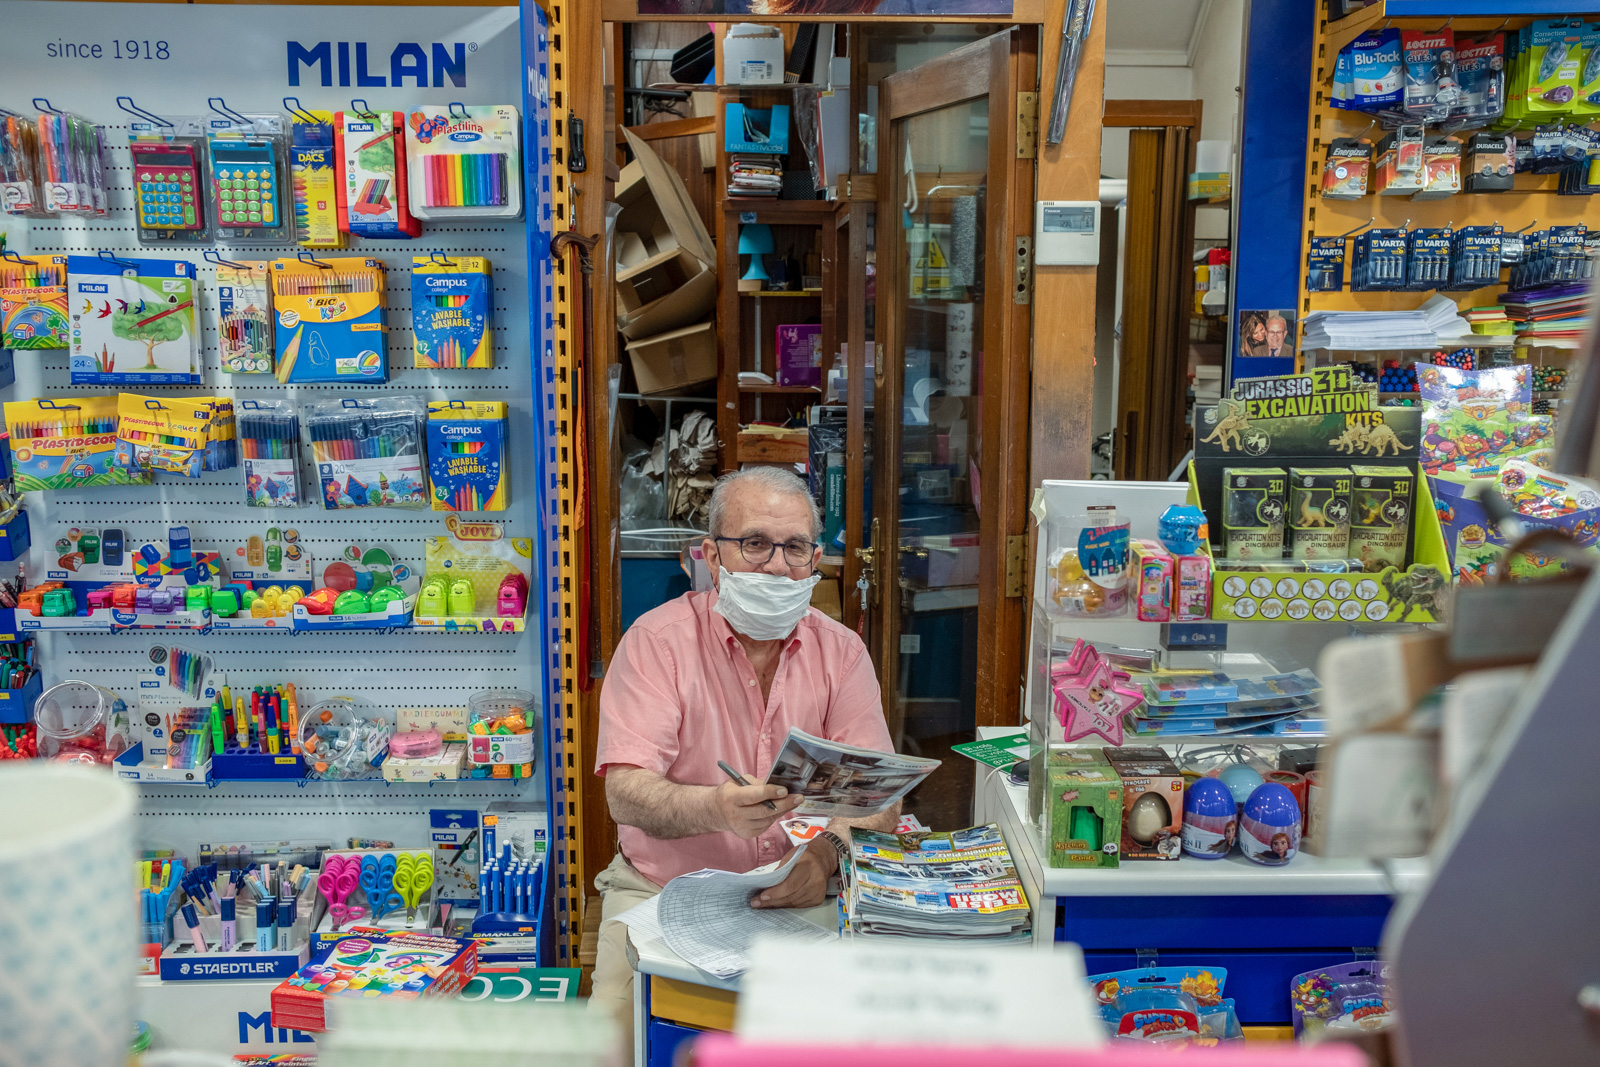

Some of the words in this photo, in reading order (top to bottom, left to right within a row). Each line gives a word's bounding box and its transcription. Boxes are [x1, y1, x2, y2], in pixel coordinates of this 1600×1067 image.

[47, 38, 102, 58] since
[113, 40, 170, 60] 1918
[1406, 38, 1446, 50] LOCTITE
[1456, 45, 1496, 59] LOCTITE
[528, 65, 548, 104] MILAN
[437, 121, 483, 135] Plastilina
[1571, 132, 1590, 142] VARTA
[1333, 148, 1367, 156] Energizer
[1424, 146, 1456, 155] Energizer
[298, 153, 324, 162] DACS
[426, 277, 467, 289] Campus
[236, 288, 244, 298] 12
[431, 310, 462, 321] LAVABLE
[431, 318, 470, 330] WASHABLE
[419, 343, 428, 351] 12
[1234, 378, 1312, 400] JURASSIC
[1315, 369, 1351, 394] 3D
[1246, 392, 1369, 419] EXCAVATION
[124, 416, 164, 428] PLASTIDECOR
[168, 423, 198, 432] Peques
[1345, 412, 1383, 428] KITS
[440, 425, 482, 437] Campus
[32, 436, 117, 449] PLASTIDECOR
[447, 457, 478, 468] LAVABLE
[335, 464, 345, 474] 20
[448, 464, 486, 476] WASHABLE
[1268, 480, 1283, 493] 3D
[1336, 480, 1350, 492] 3D
[1394, 481, 1409, 494] 3D
[437, 489, 448, 497] 24
[460, 526, 497, 538] JOVI
[1231, 534, 1266, 542] EXCAVATION
[1297, 534, 1332, 542] EXCAVATION
[1068, 694, 1091, 713] STATIONERY
[950, 890, 1018, 902] MOBIL
[957, 897, 1019, 908] REISE
[386, 941, 418, 949] Pinturas
[390, 937, 427, 946] Peintures
[193, 963, 274, 974] STAEDTLER
[1344, 998, 1382, 1014] SUPER
[1133, 1013, 1173, 1029] SUPER
